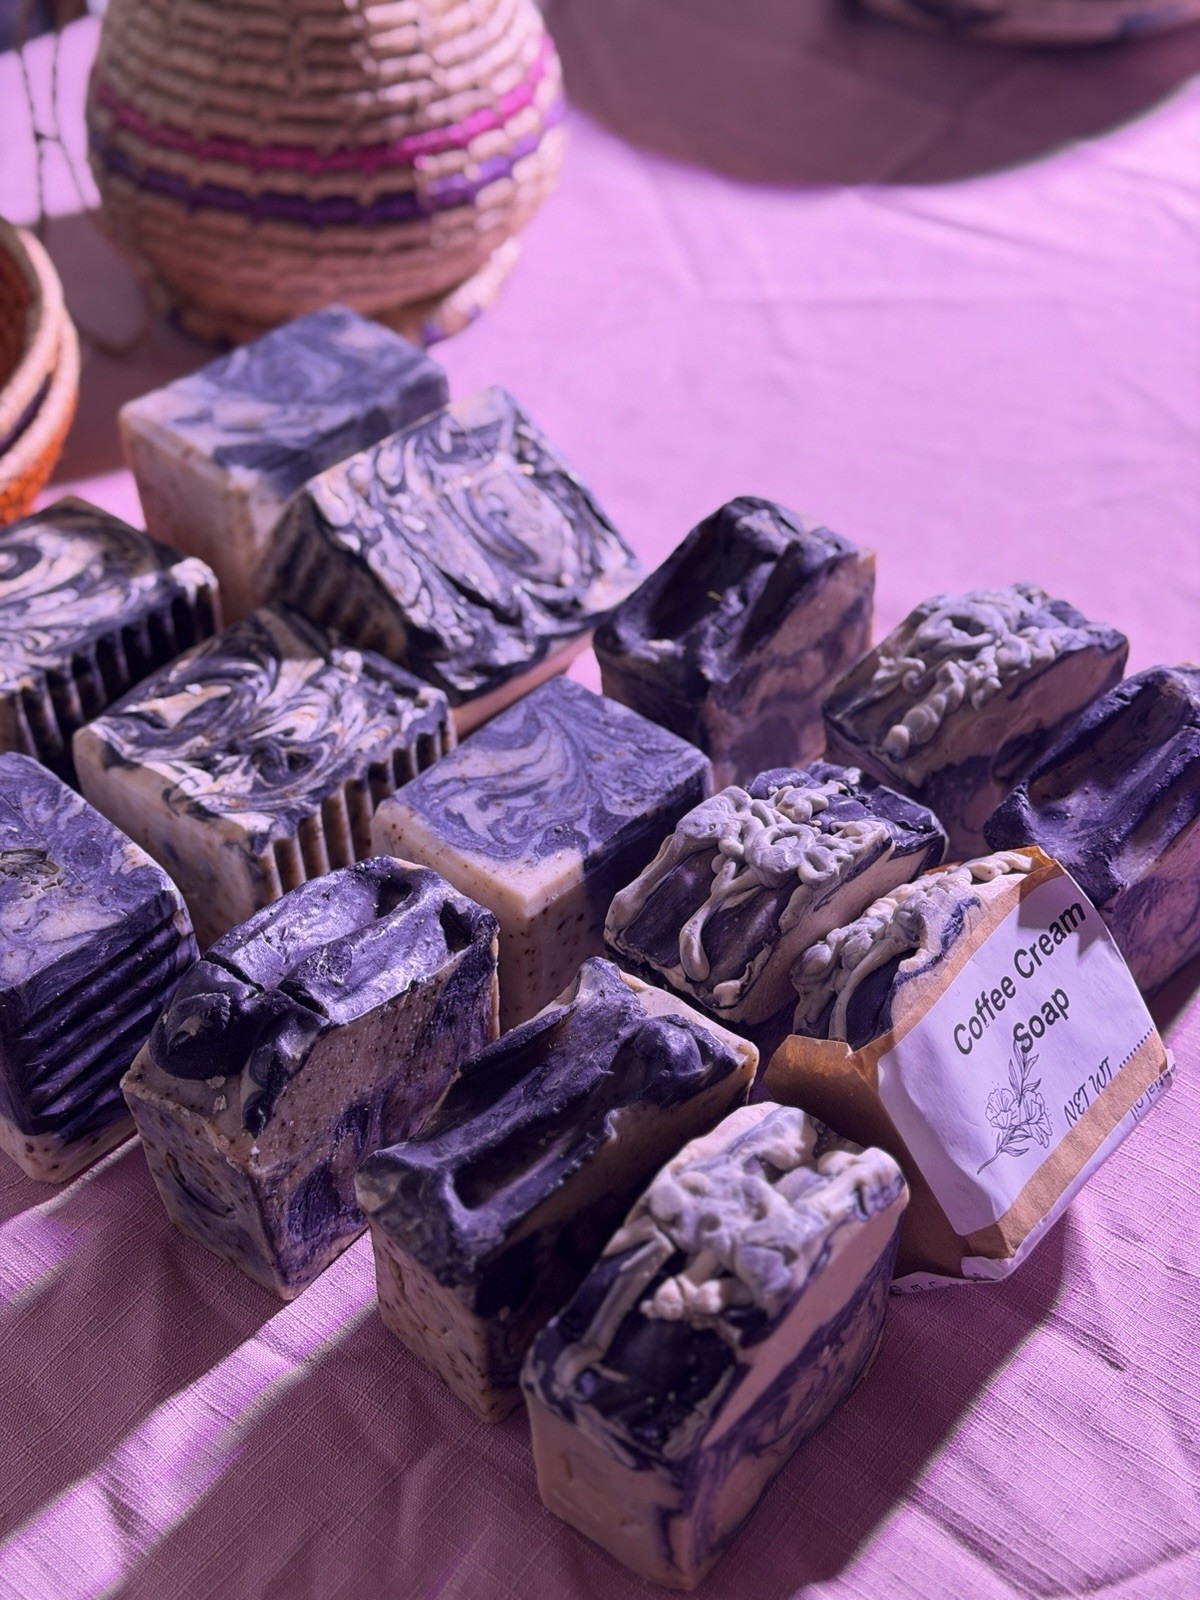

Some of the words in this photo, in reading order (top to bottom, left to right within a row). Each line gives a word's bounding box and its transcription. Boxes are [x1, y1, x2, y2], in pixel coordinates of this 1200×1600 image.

[953, 976, 1017, 1055] Coffee
[1013, 902, 1087, 979] Cream
[1013, 988, 1070, 1054] Soap
[1063, 1083, 1091, 1128] NET
